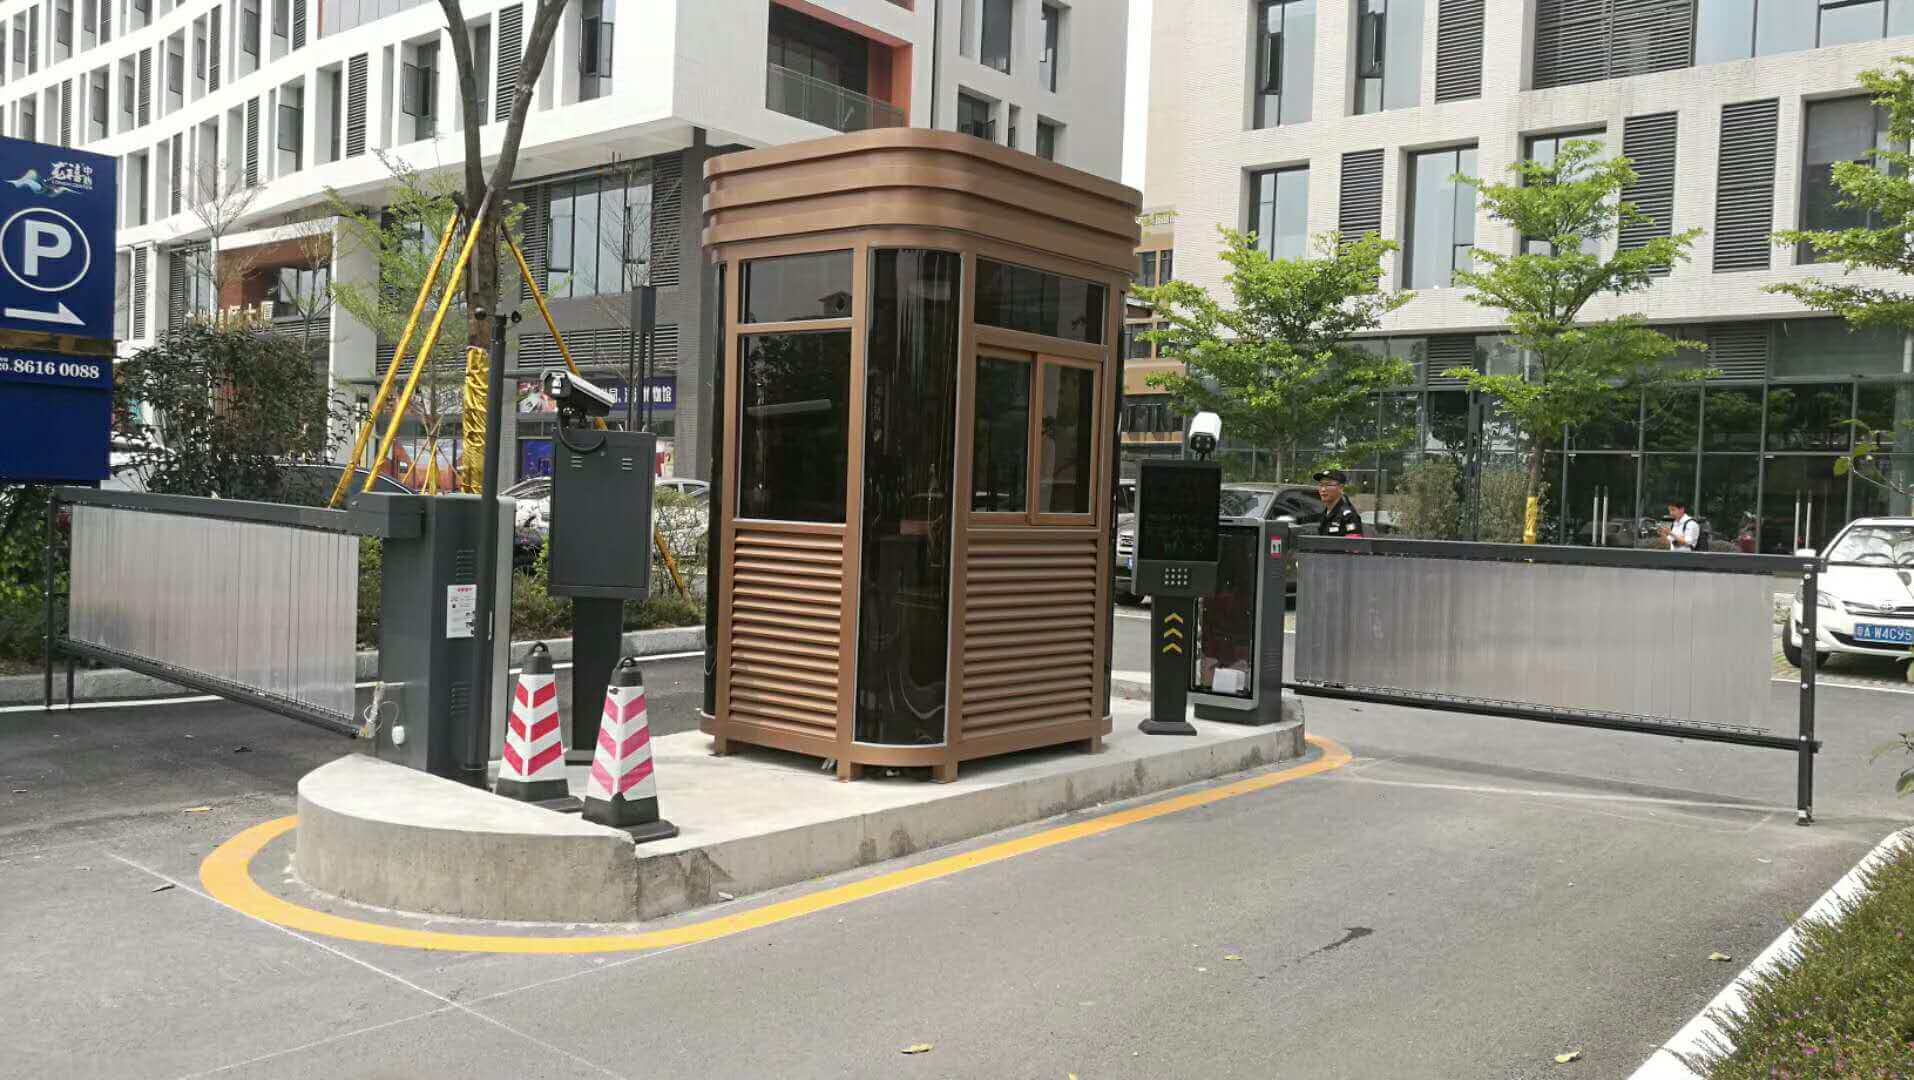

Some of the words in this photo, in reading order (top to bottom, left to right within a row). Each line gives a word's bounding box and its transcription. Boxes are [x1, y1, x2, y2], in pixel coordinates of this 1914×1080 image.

[24, 219, 72, 276] P
[14, 359, 55, 375] 8616
[59, 362, 100, 379] 0088
